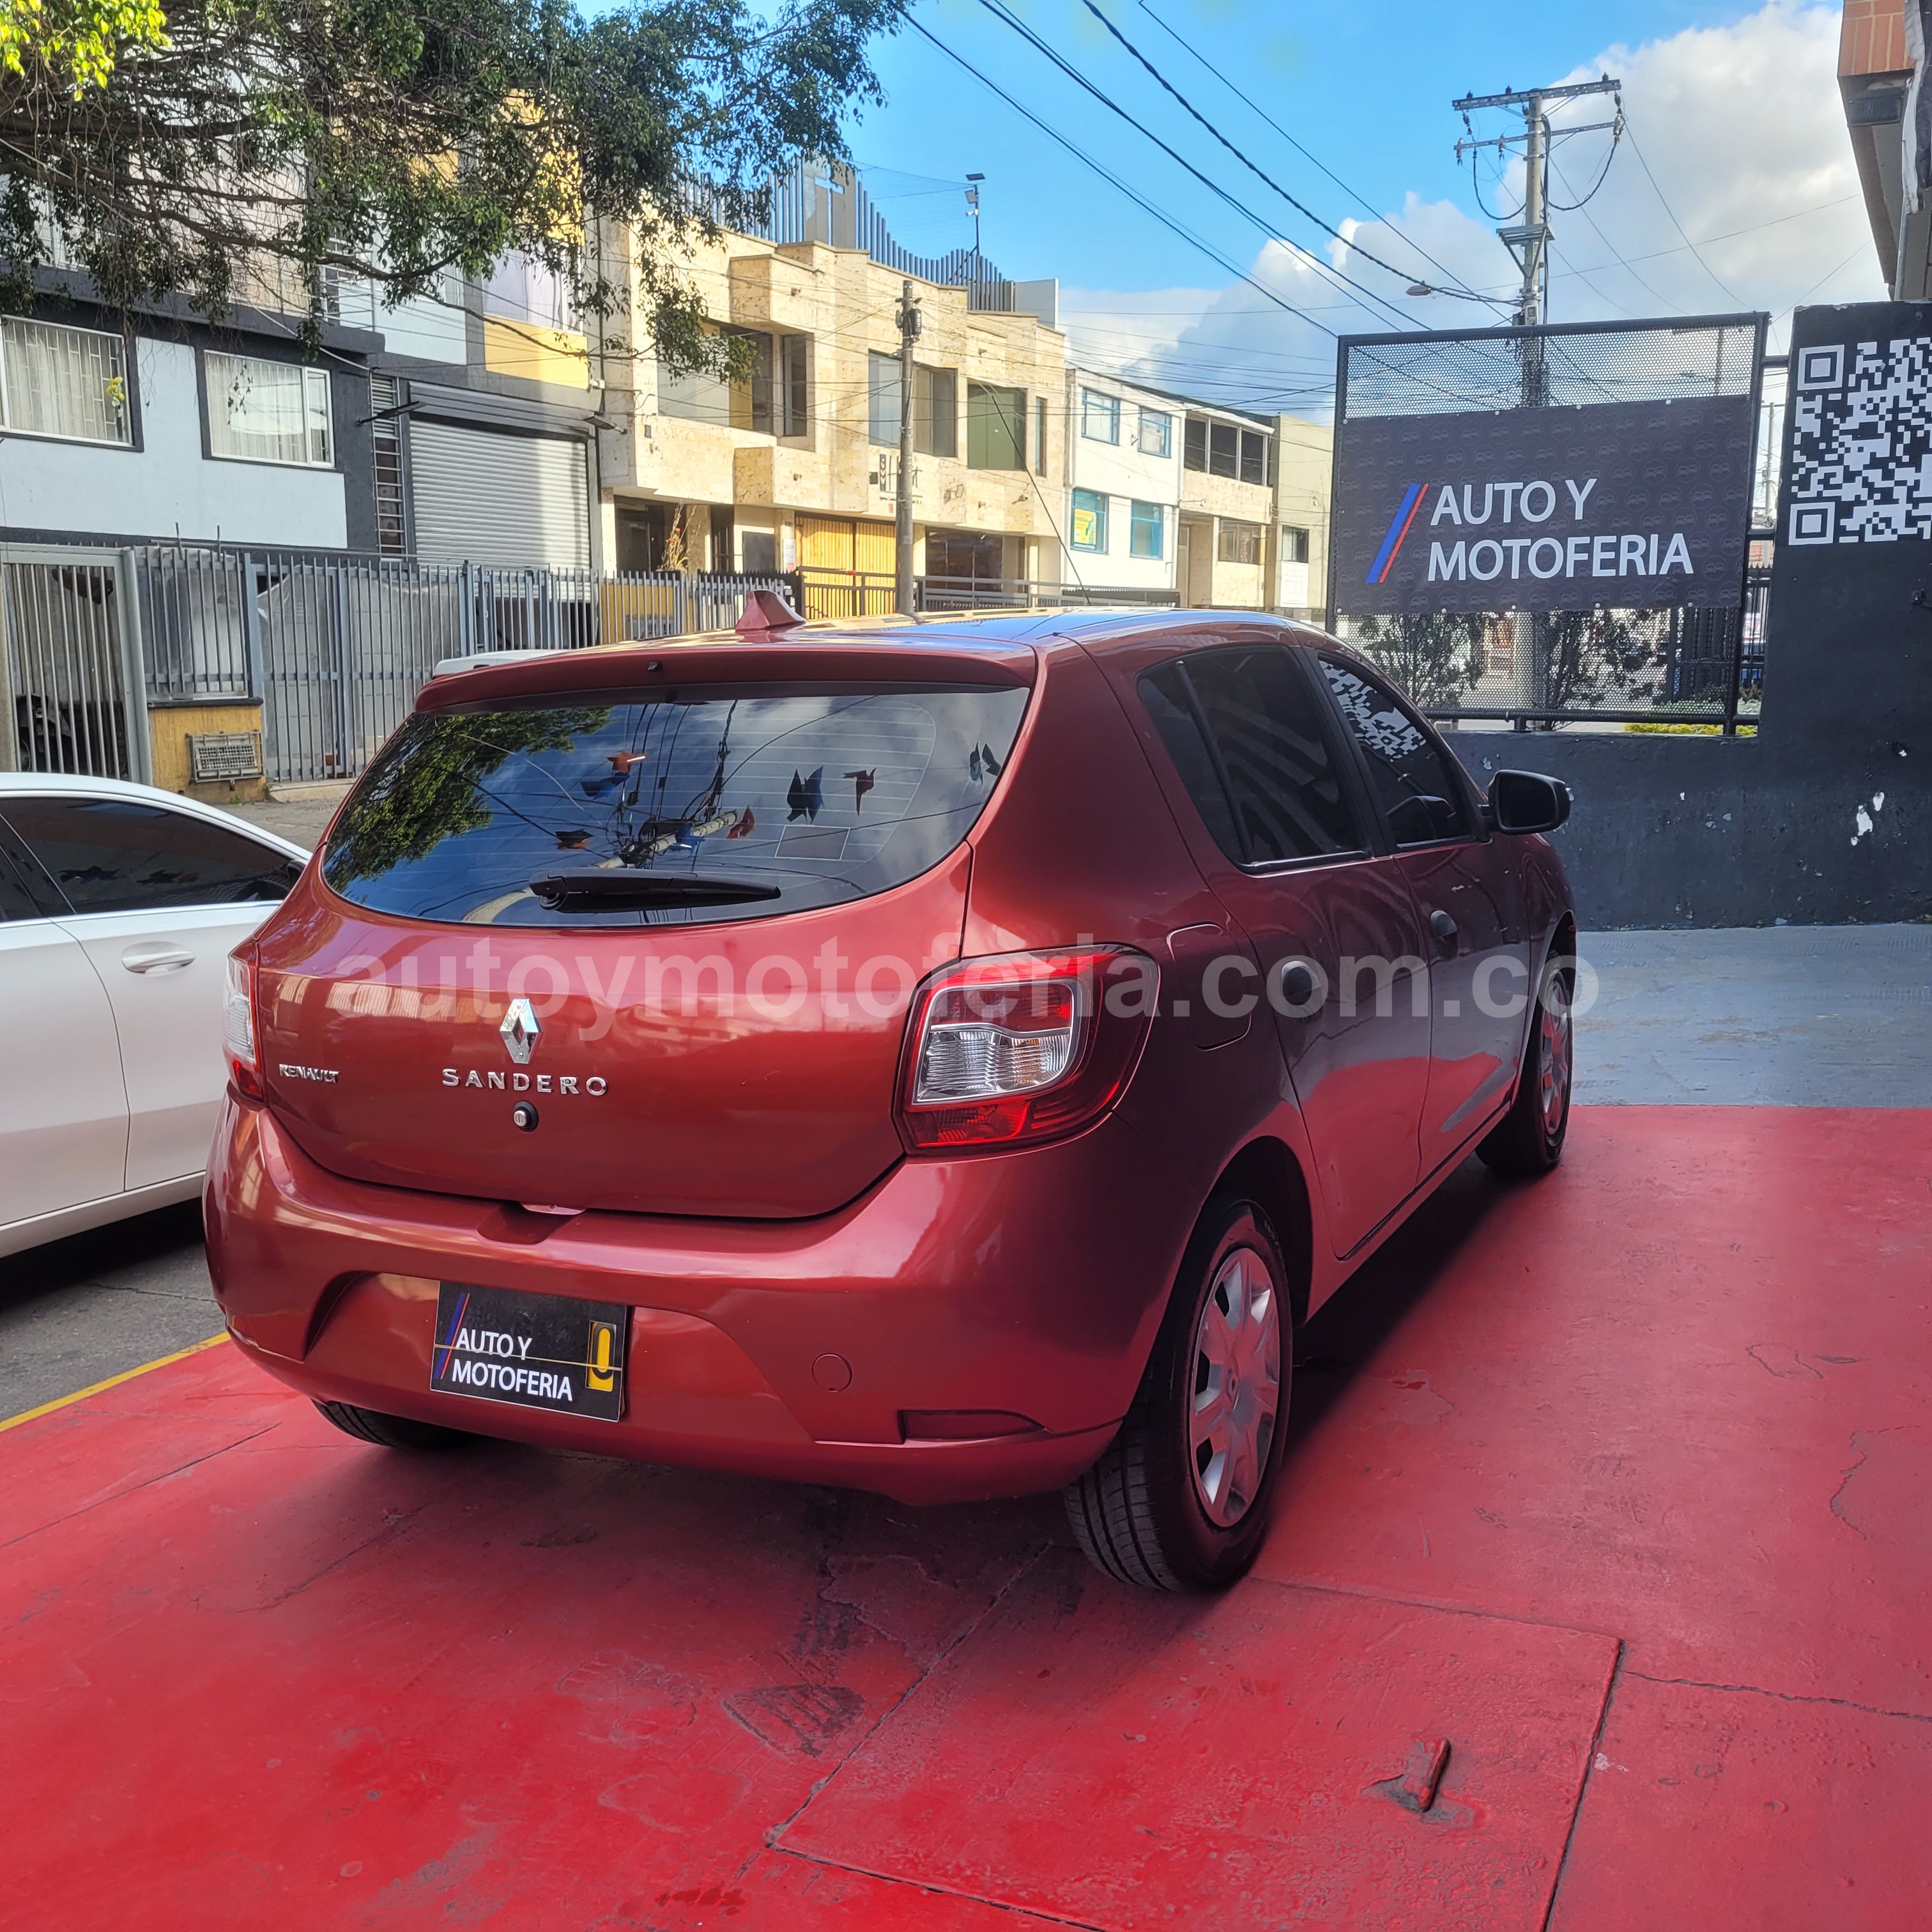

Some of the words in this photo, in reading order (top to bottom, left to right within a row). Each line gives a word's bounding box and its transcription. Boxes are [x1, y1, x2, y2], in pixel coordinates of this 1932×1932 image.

[1430, 480, 1556, 525] AUTO
[1565, 478, 1597, 520] Y
[1427, 533, 1694, 581] MOTOFERIA
[279, 1063, 339, 1084] RENAULT
[442, 1068, 607, 1096] SANDERO
[456, 1328, 514, 1358] AUTO
[518, 1336, 532, 1360] Y
[452, 1358, 572, 1402] MOTOFERIA
